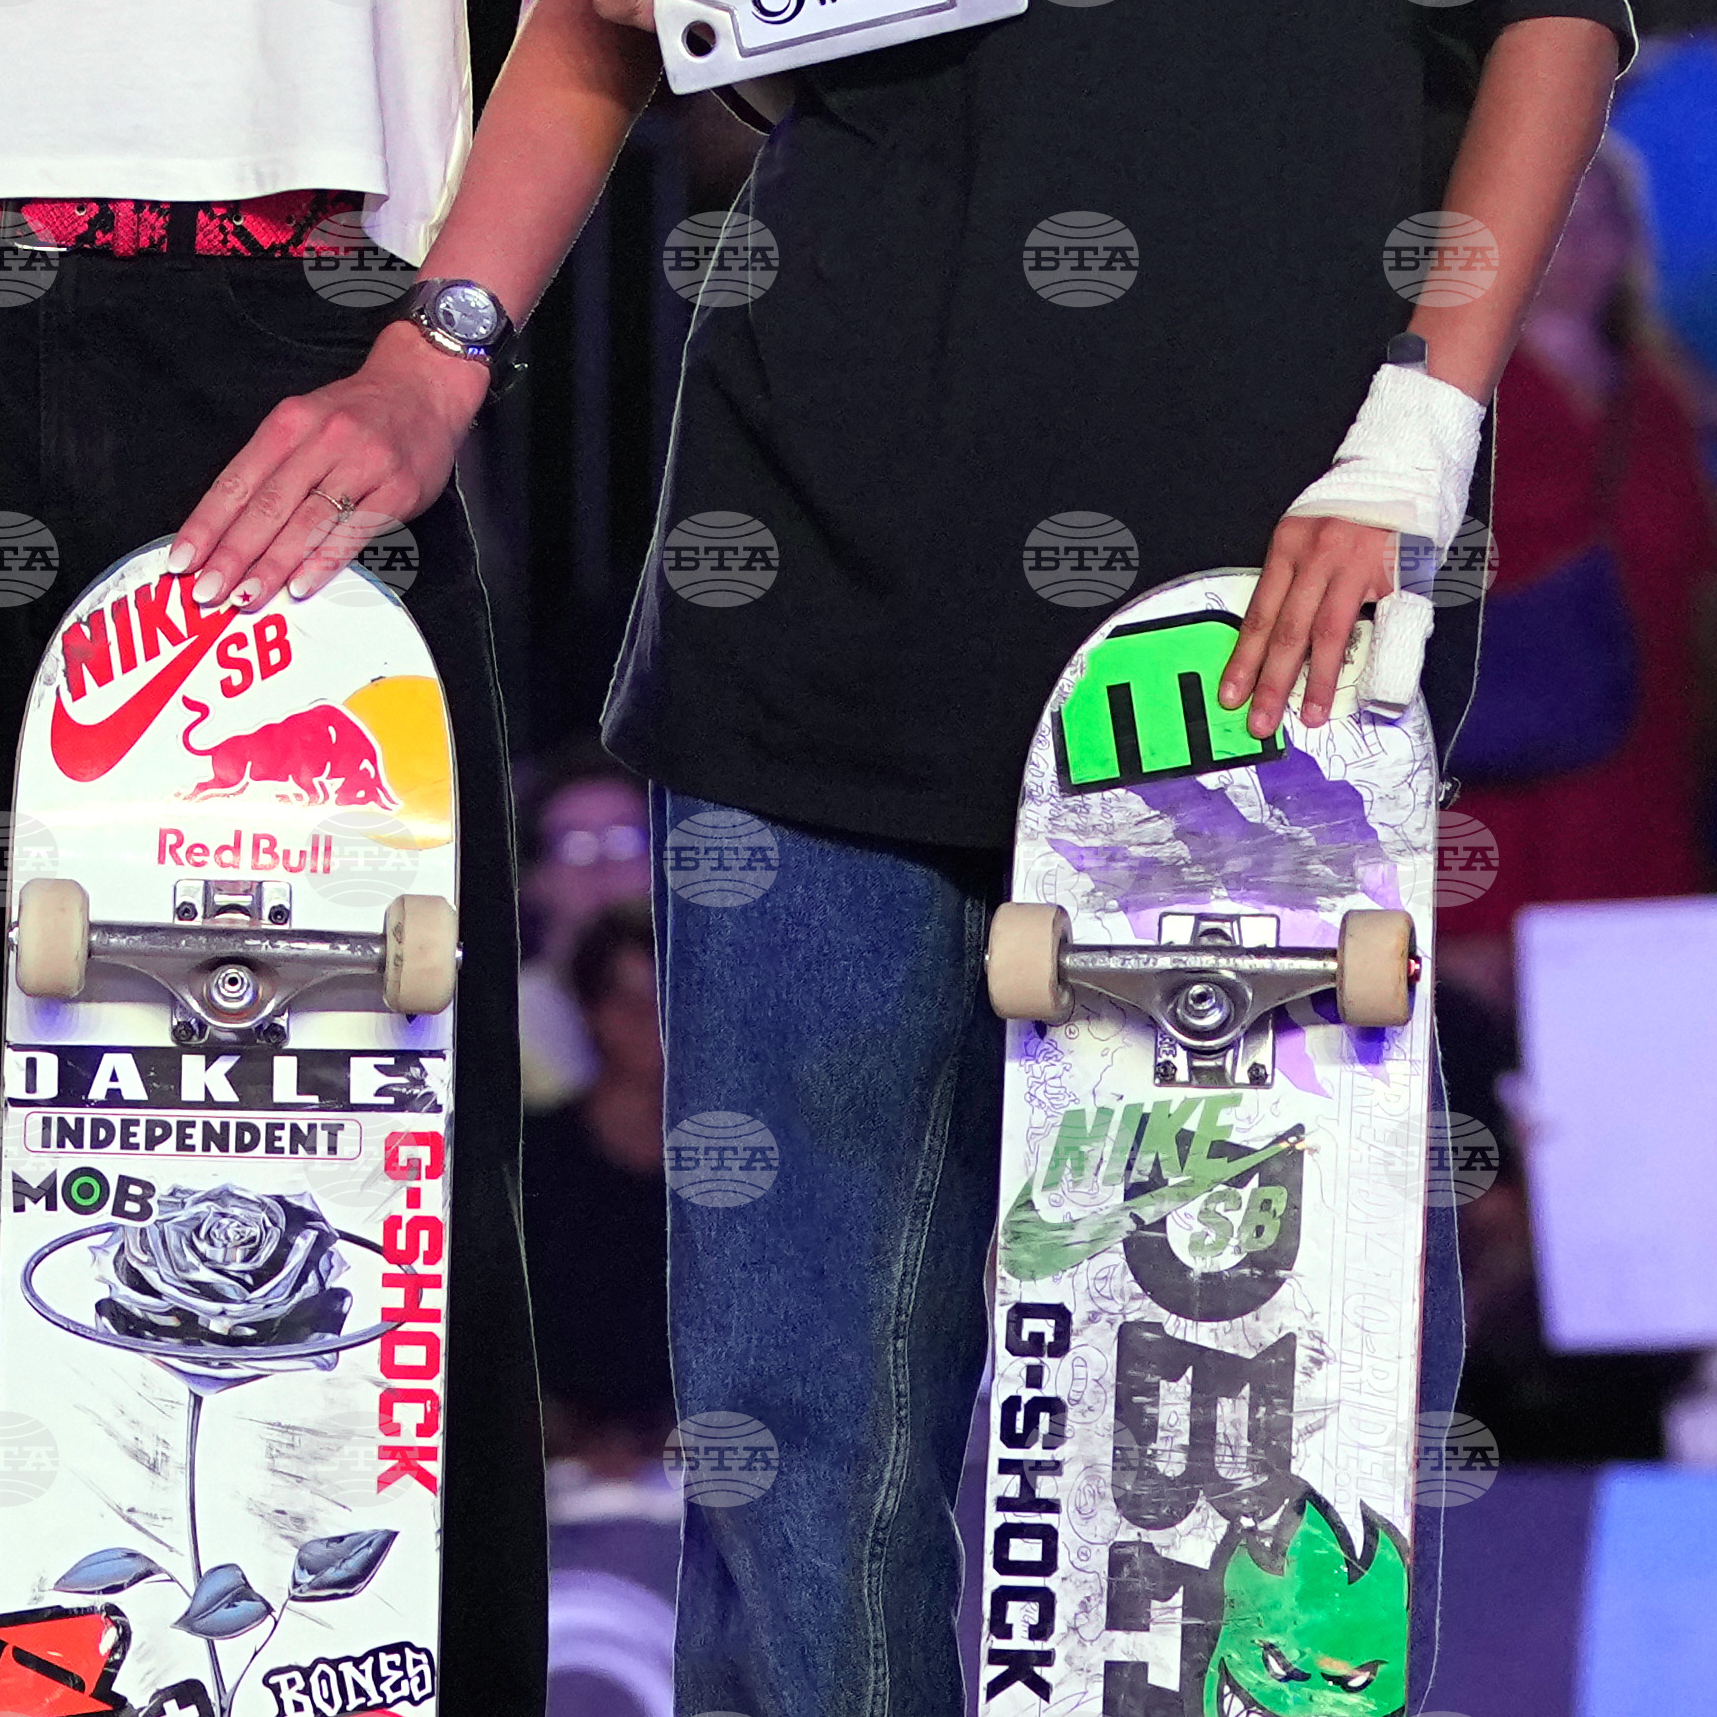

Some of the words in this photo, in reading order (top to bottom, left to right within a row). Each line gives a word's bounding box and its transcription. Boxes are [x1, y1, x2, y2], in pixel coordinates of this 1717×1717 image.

[216, 612, 293, 699] SB
[157, 828, 241, 872] Red
[251, 832, 332, 874] Bull
[5, 1050, 446, 1112] OAKLE
[41, 1116, 345, 1156] INDEPENDENT
[1041, 1092, 1243, 1192] NIKE
[11, 1167, 156, 1223] MOB
[1188, 1185, 1289, 1259] SB
[377, 1130, 444, 1498] G-SHOCK
[986, 1302, 1072, 1704] G-SHOCK
